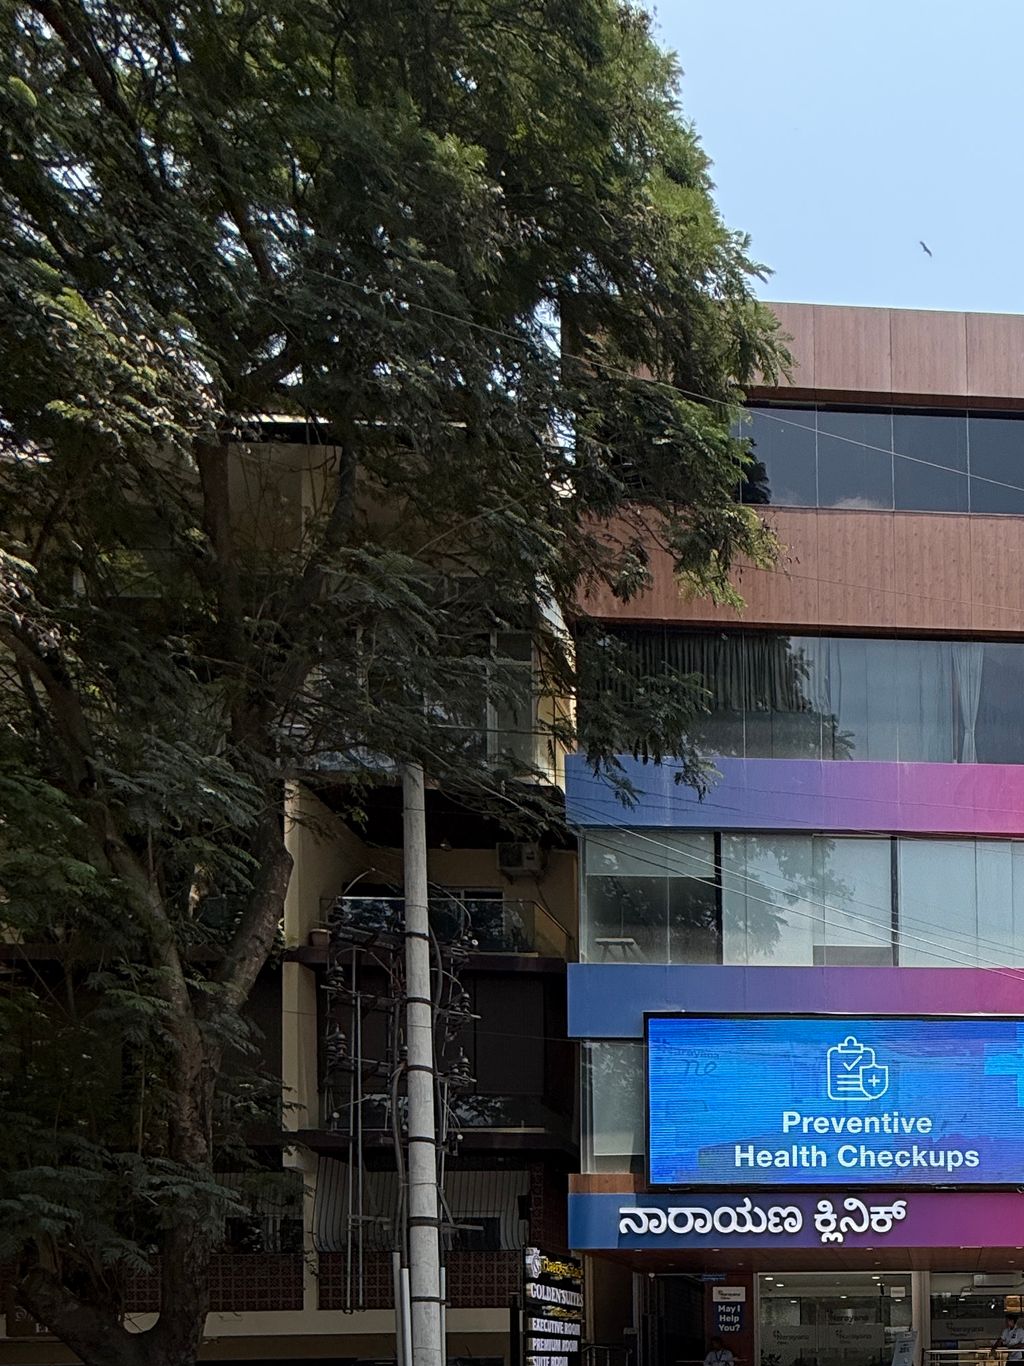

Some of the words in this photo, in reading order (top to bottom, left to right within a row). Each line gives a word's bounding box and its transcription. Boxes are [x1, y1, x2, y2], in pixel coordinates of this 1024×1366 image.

[782, 1111, 933, 1134] Preventive
[734, 1145, 827, 1167] Health
[837, 1145, 980, 1172] Checkups
[619, 1197, 803, 1234] ನಾರಾಯಣ
[814, 1197, 907, 1243] ಕ್ಲಿನಿಕ್
[530, 1283, 561, 1303] GOLDEN
[561, 1290, 583, 1307] SUITES
[718, 1304, 736, 1314] May
[532, 1318, 563, 1334] EXECUTIVE
[719, 1314, 740, 1323] Help
[718, 1324, 741, 1332] You?
[533, 1338, 561, 1351] PREMIUM
